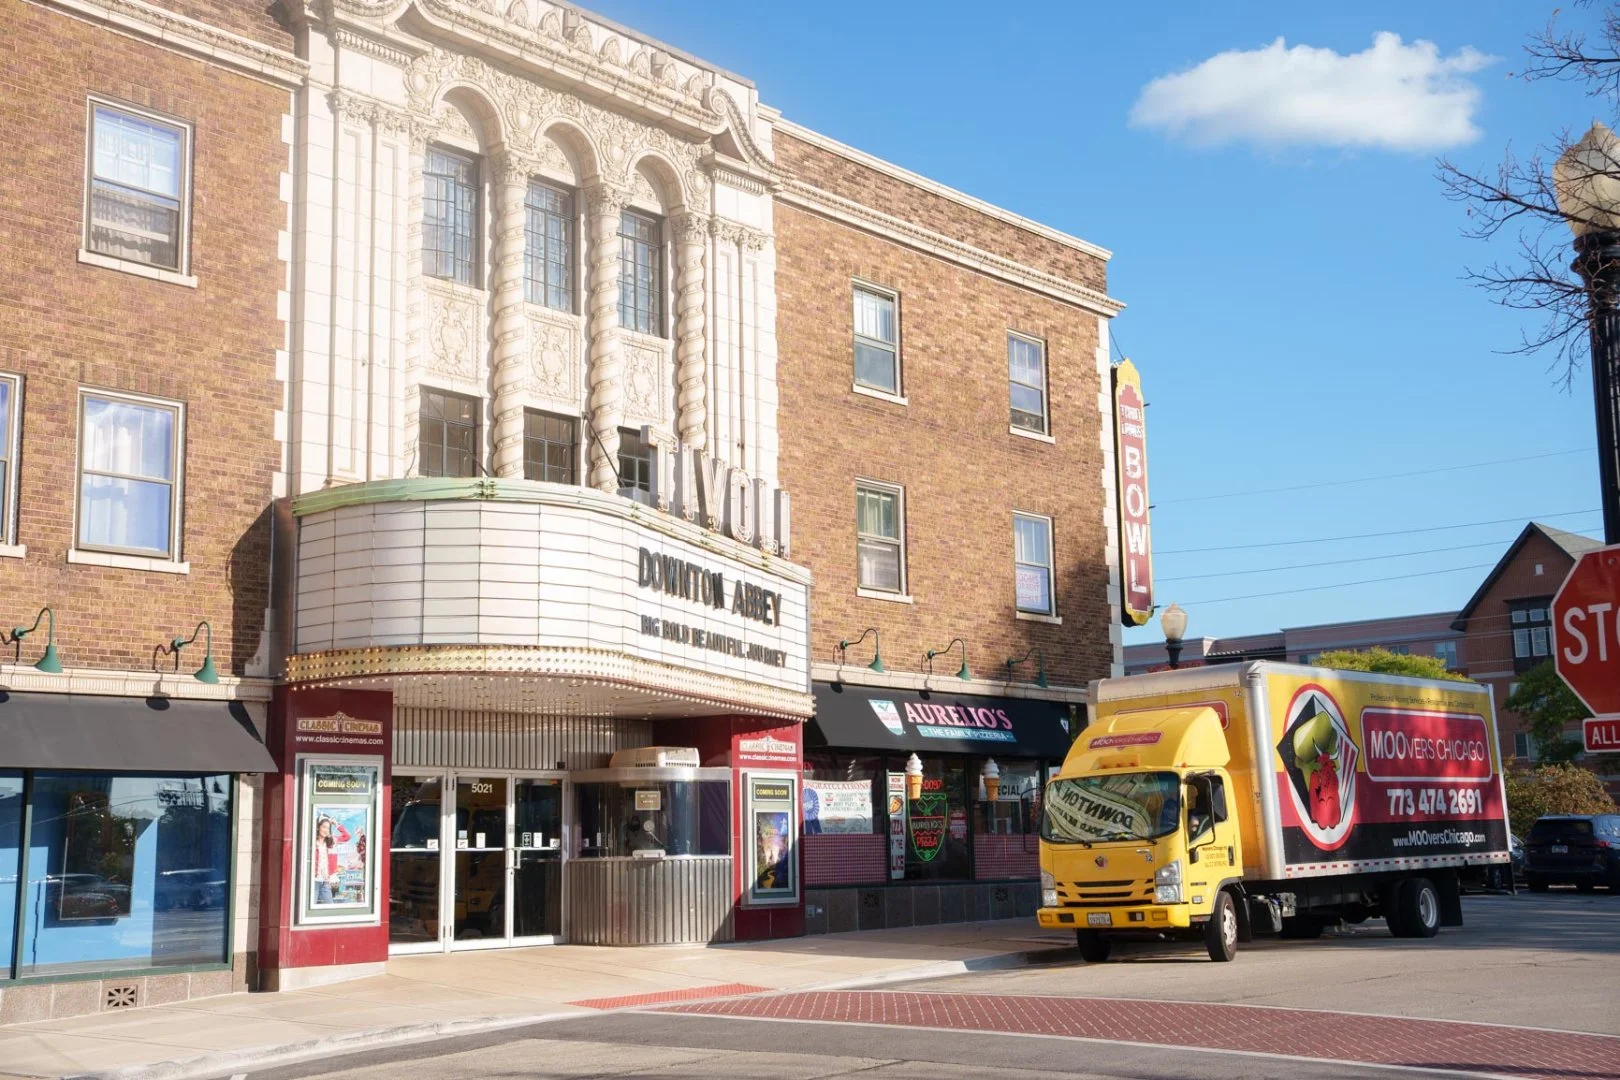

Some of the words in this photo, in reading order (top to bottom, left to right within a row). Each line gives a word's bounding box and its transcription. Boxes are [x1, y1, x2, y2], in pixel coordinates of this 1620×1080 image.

[640, 425, 791, 561] TIVOLI
[1125, 446, 1148, 594] BOWL
[638, 546, 725, 610] DOWNTON
[732, 579, 782, 628] ABBEY
[641, 614, 660, 637] BIG
[662, 619, 690, 644] BOLD
[691, 627, 746, 658] BEAUTIFUL
[746, 642, 788, 668] JOURNEY
[1563, 602, 1620, 665] ST
[903, 702, 1013, 730] AURELIO'S
[300, 720, 336, 730] CLASSIC
[344, 722, 379, 732] CINEMAS
[295, 735, 384, 745] www.classiccinemas.com
[928, 728, 944, 737] THE
[944, 729, 972, 739] FAMILY
[973, 731, 1006, 740] PIZZERIA
[1592, 726, 1620, 745] ALL
[1371, 730, 1435, 760] MOOVERS
[1436, 738, 1485, 762] CHICAGO
[318, 780, 345, 788] COMING
[471, 784, 494, 794] 5021
[803, 782, 869, 791] ONGRATULATIONS
[922, 780, 942, 790] -0097
[998, 786, 1020, 796] ECIAL
[1386, 788, 1416, 816] 773
[1418, 788, 1447, 815] 474
[1448, 788, 1483, 814] 2691
[892, 820, 904, 835] IZZA
[913, 820, 944, 830] AURELIO'S
[917, 836, 938, 847] PIZZA
[1392, 828, 1486, 847] www.MOOversChicago.com
